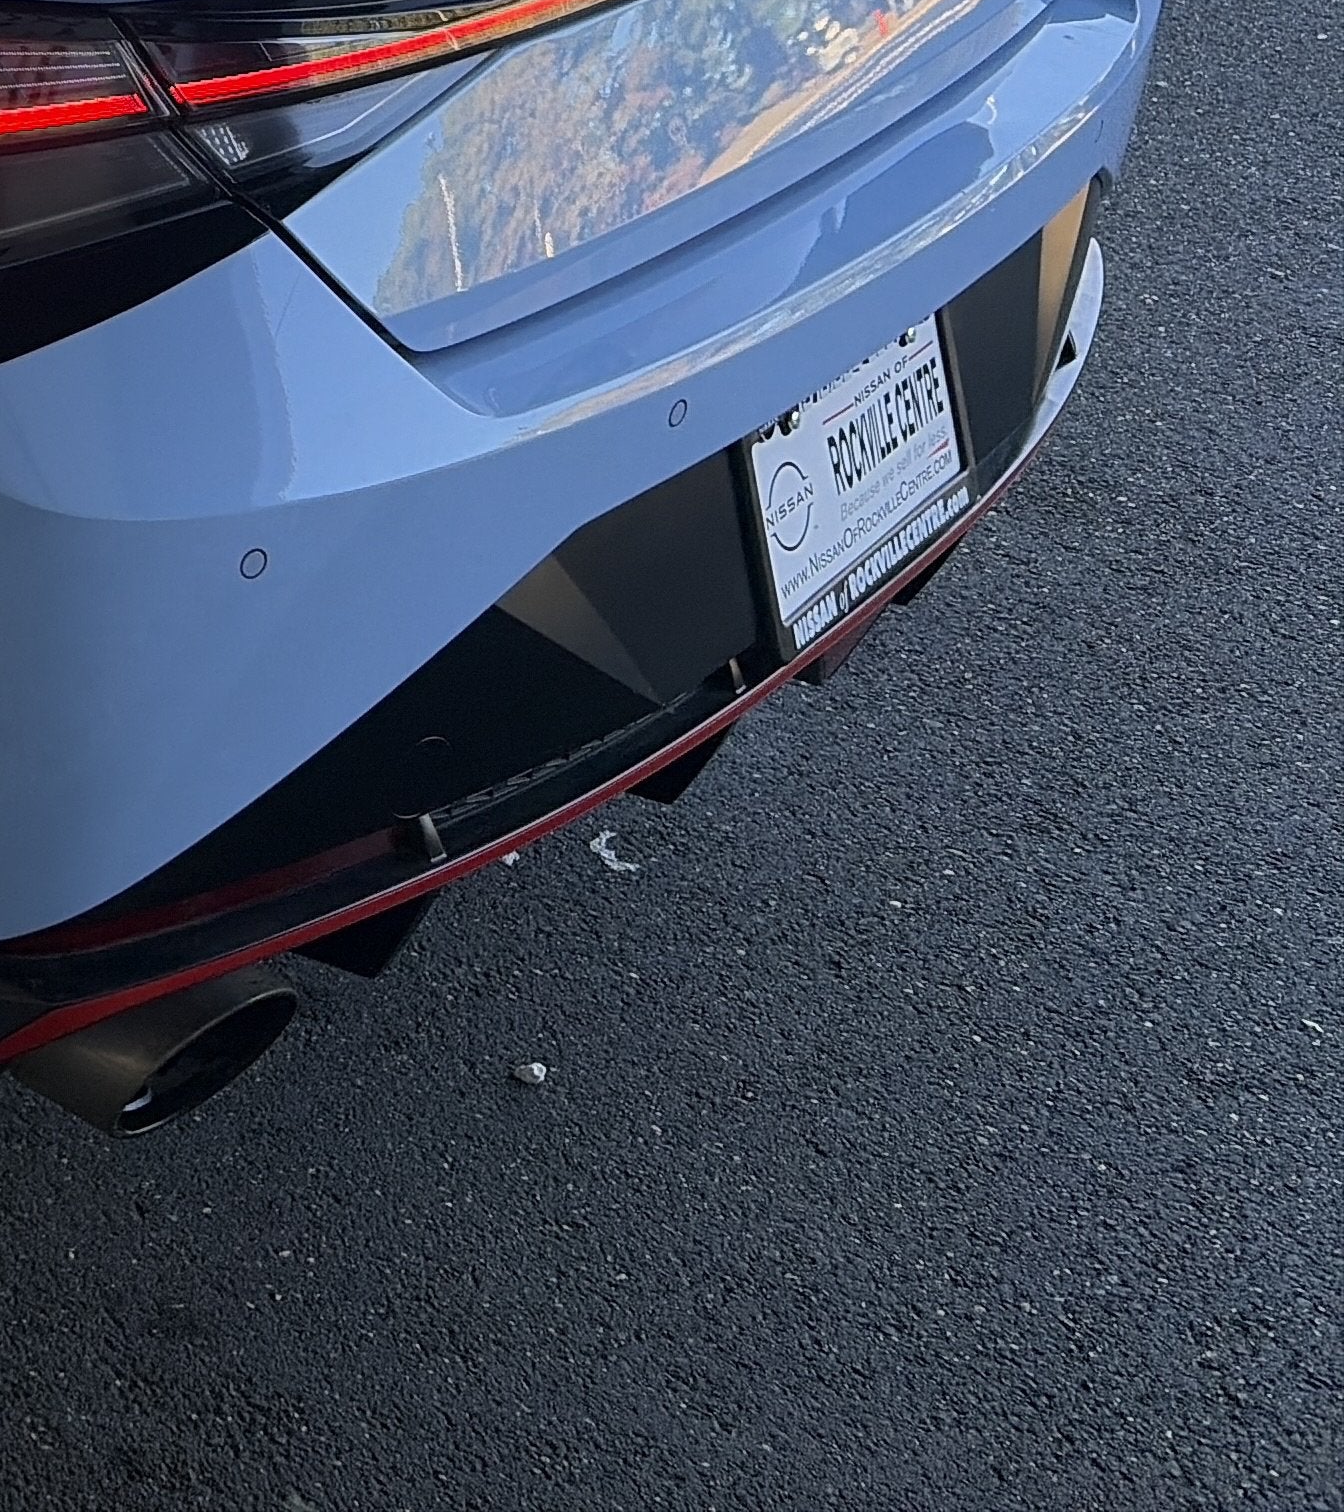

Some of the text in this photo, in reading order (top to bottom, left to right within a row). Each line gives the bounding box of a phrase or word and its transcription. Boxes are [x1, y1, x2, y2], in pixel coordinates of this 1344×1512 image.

[853, 355, 909, 408] NISSAN OF
[826, 391, 899, 496] ROCKVILLE
[894, 356, 945, 443] CENTRE
[764, 482, 814, 530] NISSAN
[840, 480, 881, 522] Because
[882, 468, 895, 487] we
[896, 449, 913, 475] sell
[913, 441, 926, 461] for
[792, 485, 970, 650] NISSAN of ROCKVILLECENTRE.com
